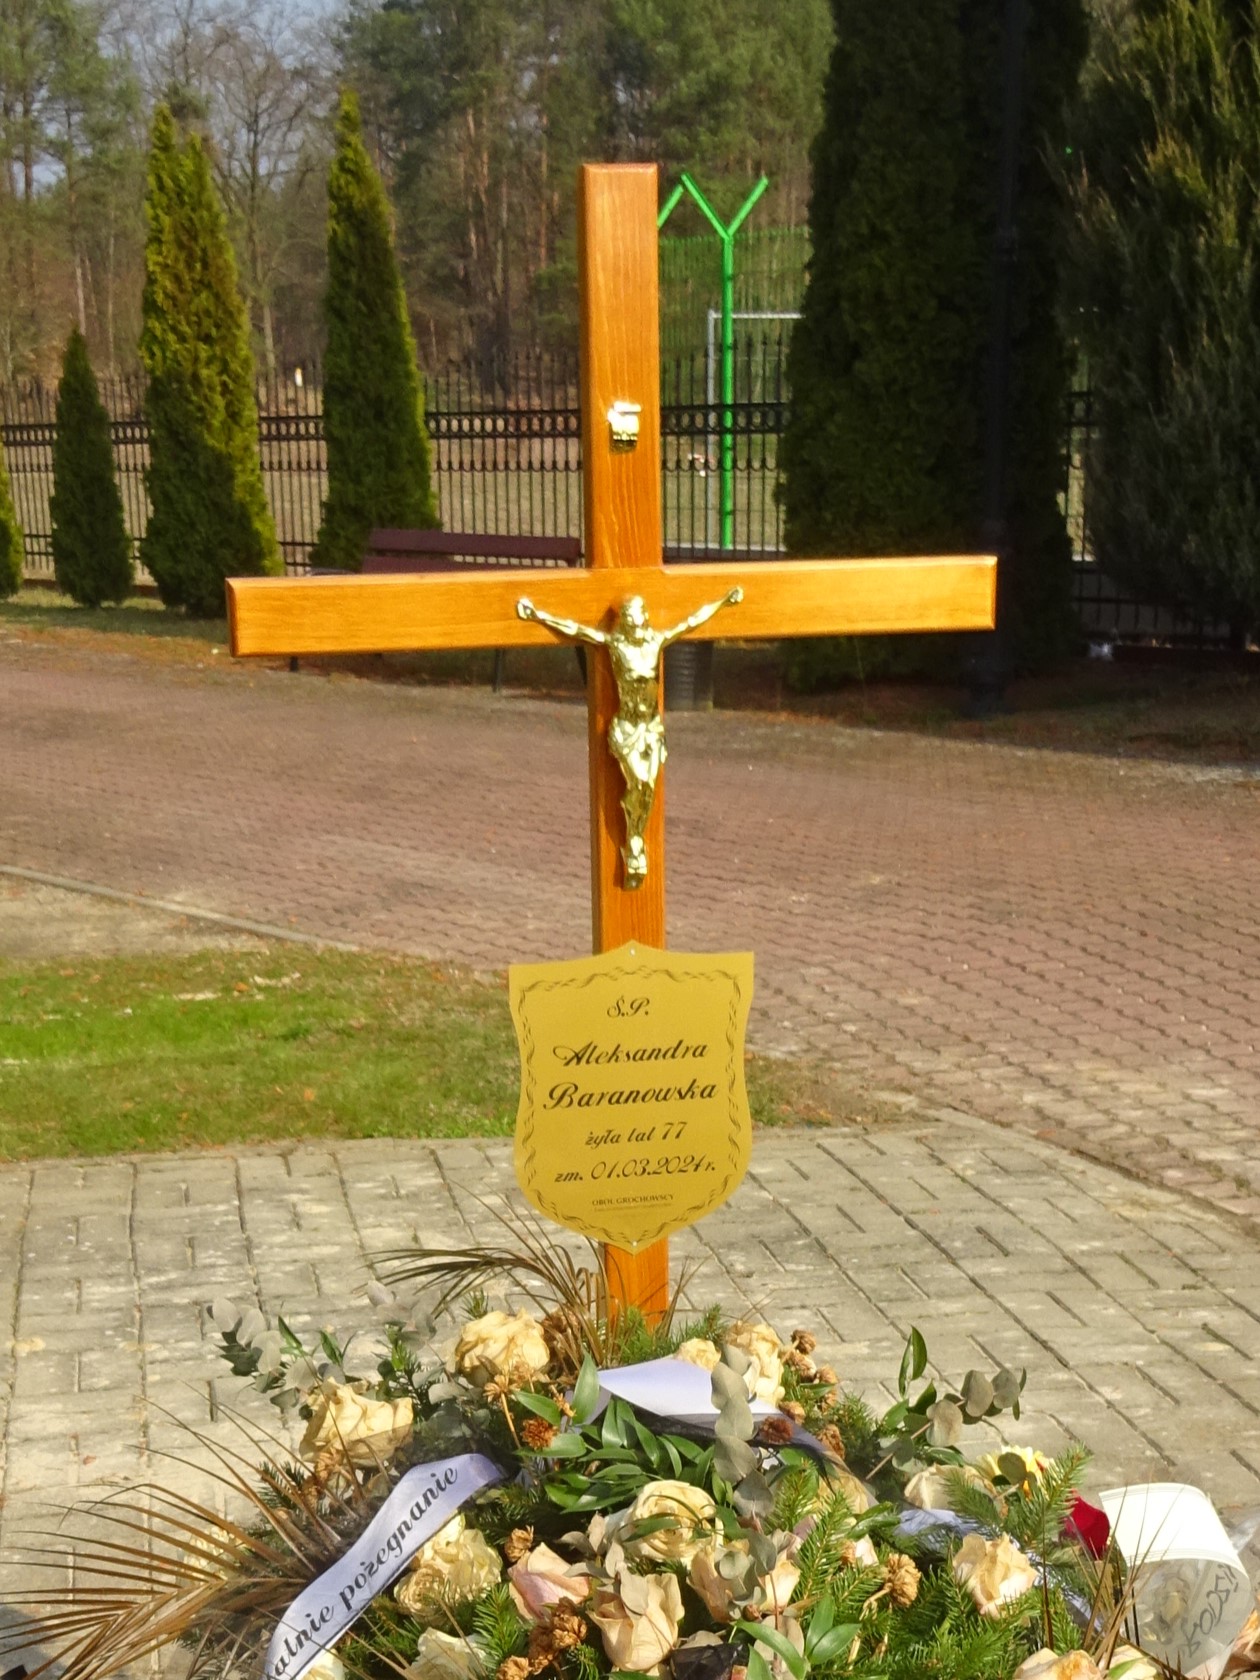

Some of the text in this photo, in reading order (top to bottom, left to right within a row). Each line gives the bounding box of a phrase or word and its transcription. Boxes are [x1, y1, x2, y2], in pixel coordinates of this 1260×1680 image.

[552, 1039, 708, 1067] Aleksandra
[542, 1078, 718, 1110] Baranowska
[585, 1121, 688, 1149] żyła lat 77
[554, 1171, 584, 1183] zm.
[338, 1466, 459, 1611] pożegnanie
